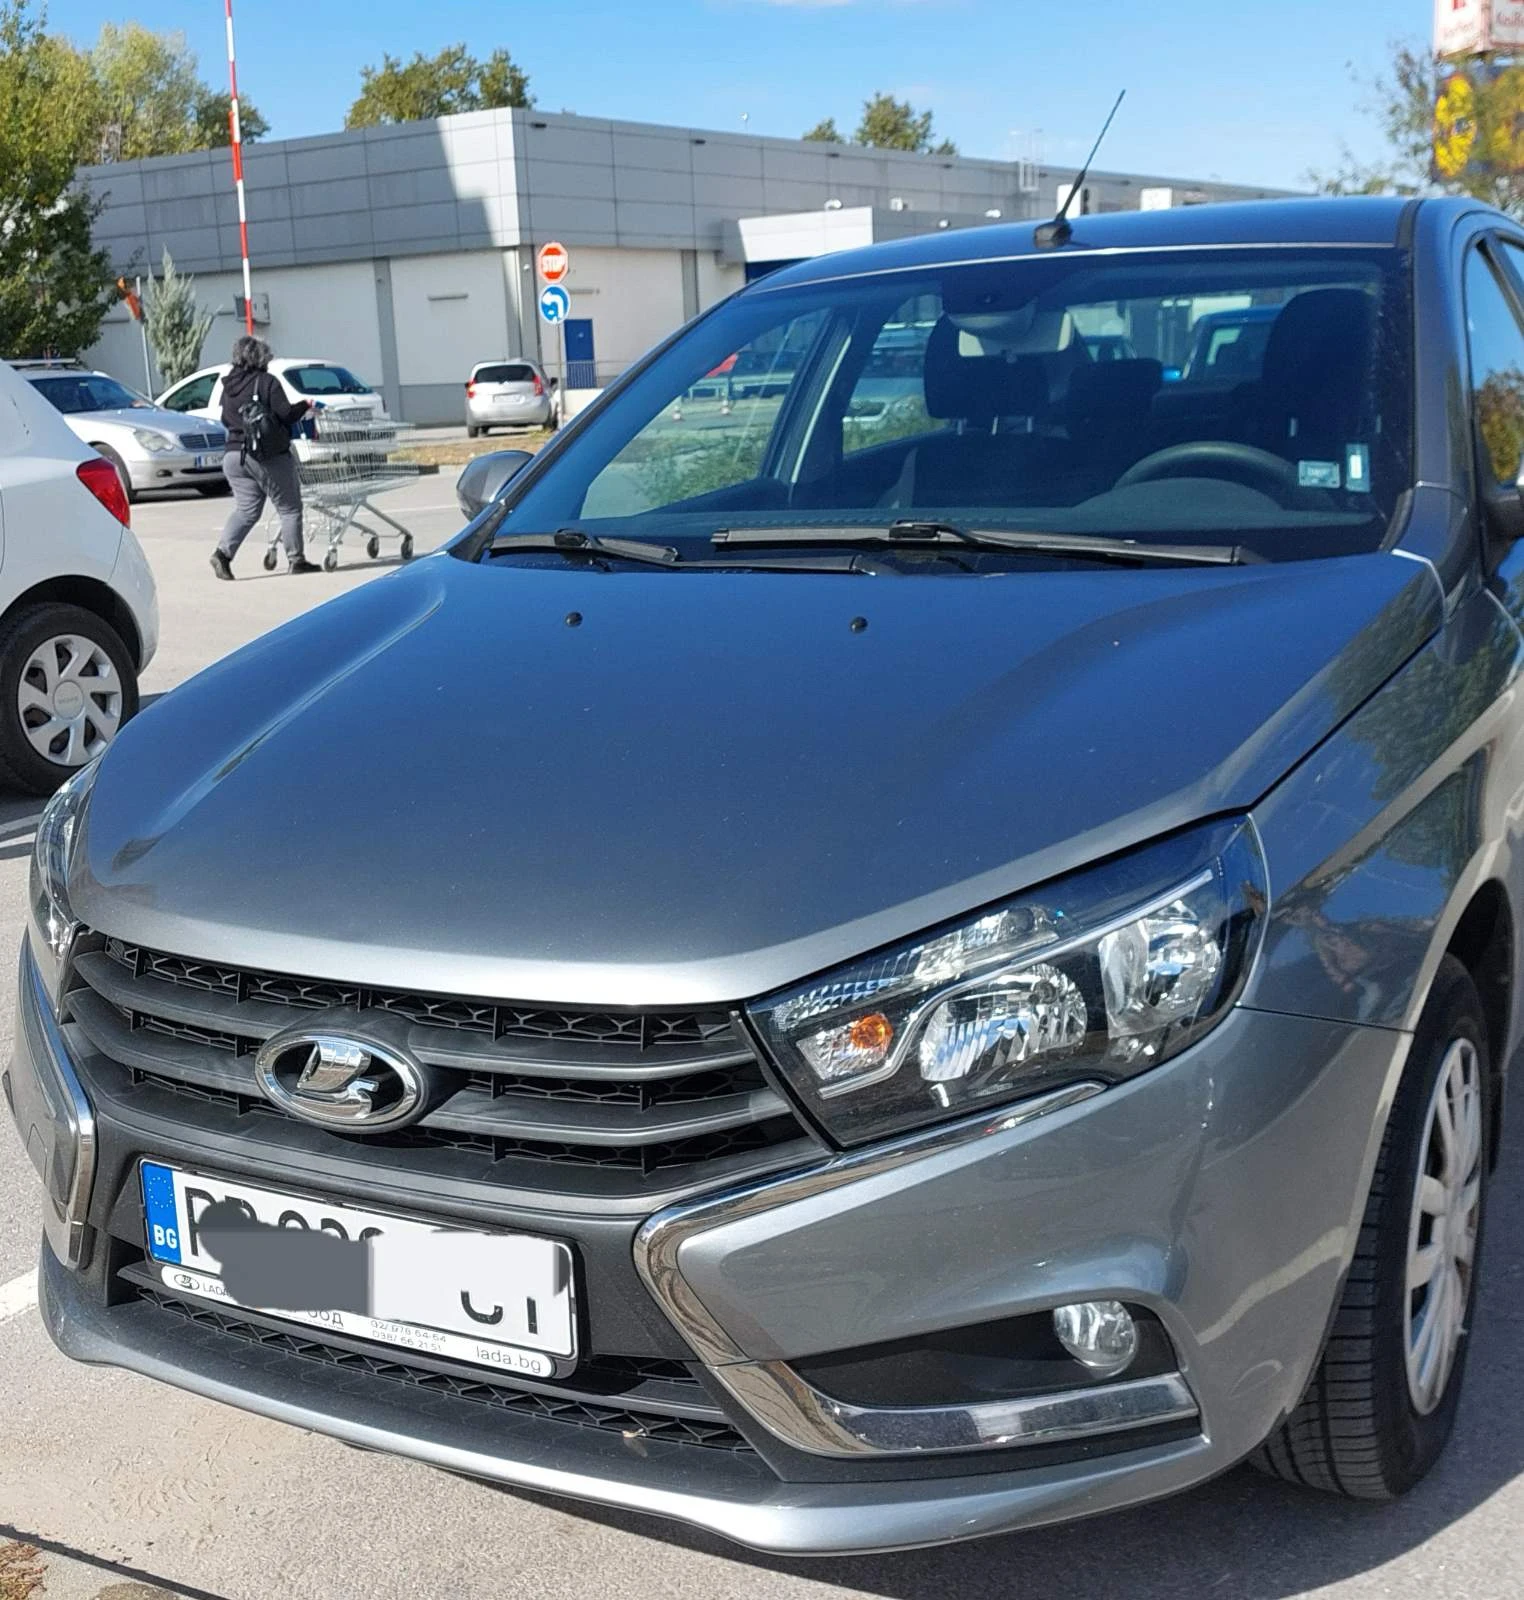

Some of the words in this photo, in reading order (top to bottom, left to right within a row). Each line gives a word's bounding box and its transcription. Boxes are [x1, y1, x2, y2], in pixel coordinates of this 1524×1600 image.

[542, 254, 567, 273] STOP
[153, 1223, 178, 1249] BG
[476, 1345, 541, 1374] lada.bg
